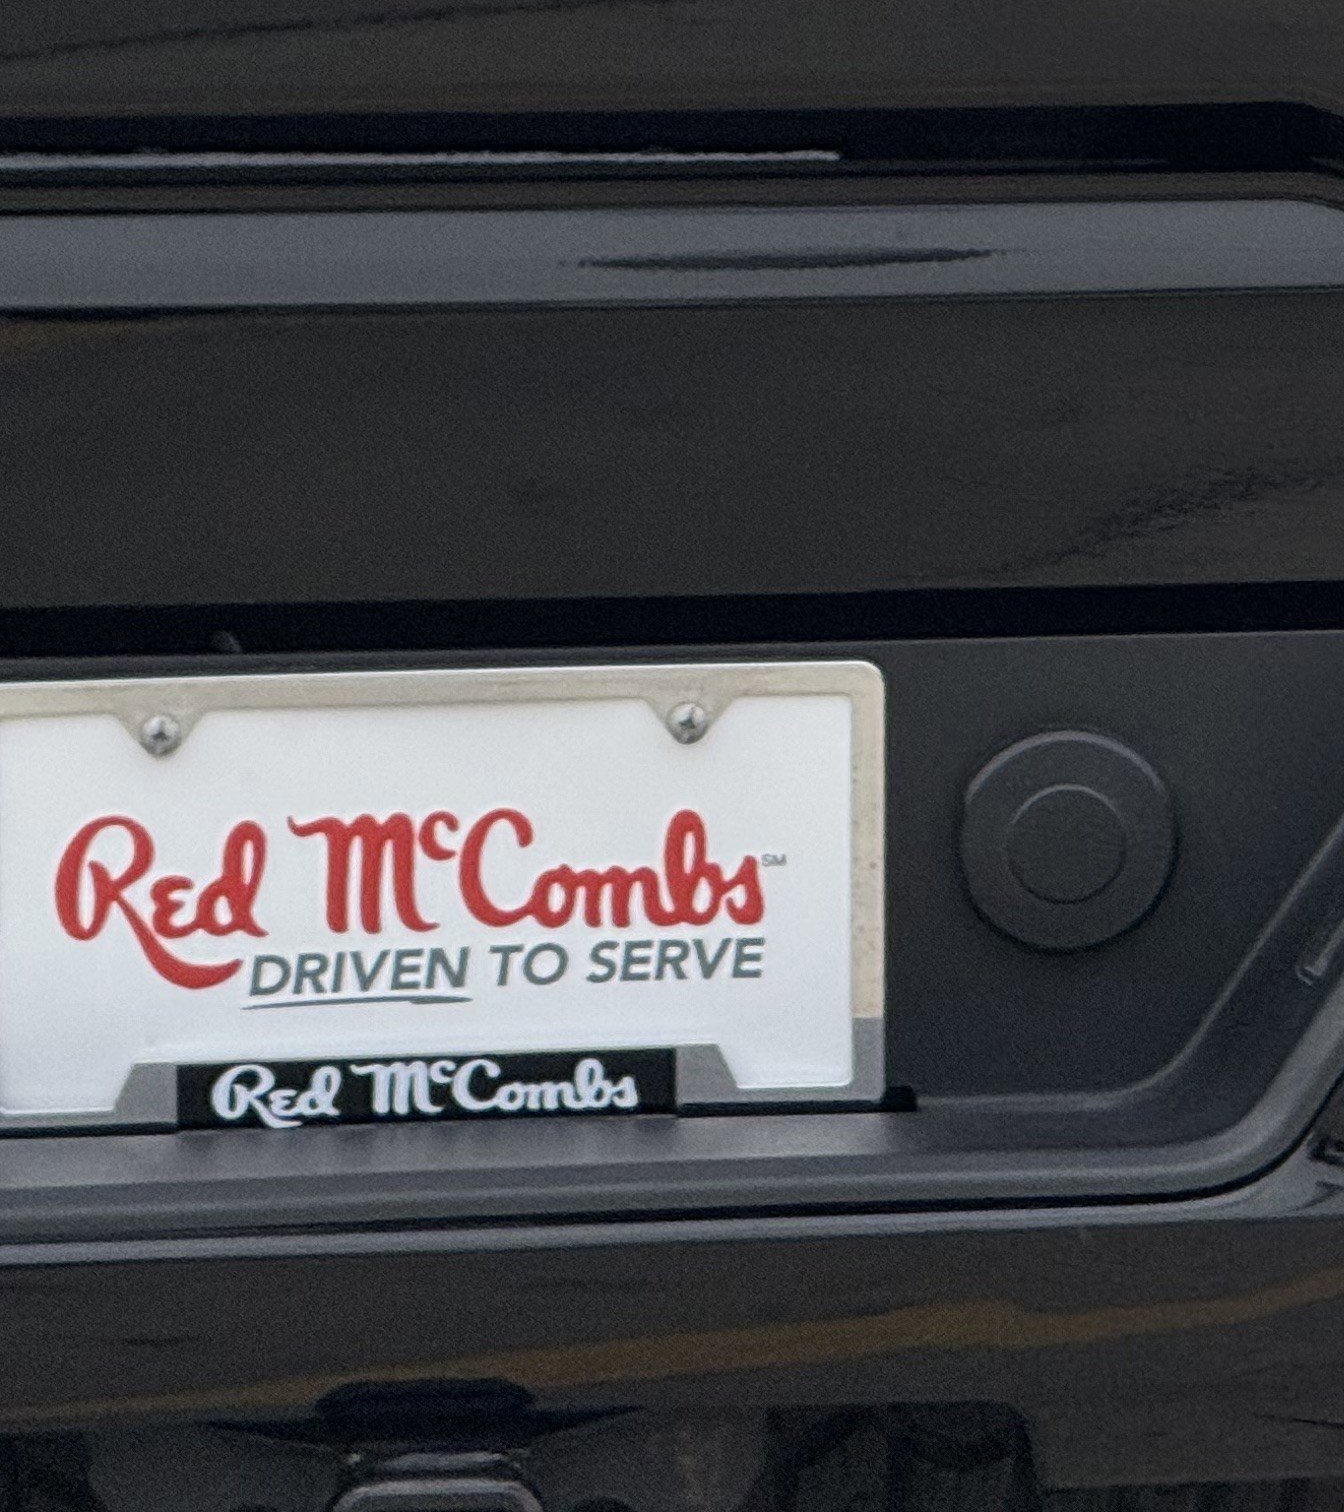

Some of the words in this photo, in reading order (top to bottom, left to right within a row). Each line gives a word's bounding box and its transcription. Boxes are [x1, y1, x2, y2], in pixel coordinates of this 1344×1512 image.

[55, 816, 267, 989] Red
[288, 809, 764, 934] McCombs
[249, 946, 470, 996] DRIVEN
[489, 942, 569, 987] TO
[586, 937, 766, 984] SERVE
[211, 1064, 341, 1129] Red
[350, 1057, 639, 1115] McCombs
